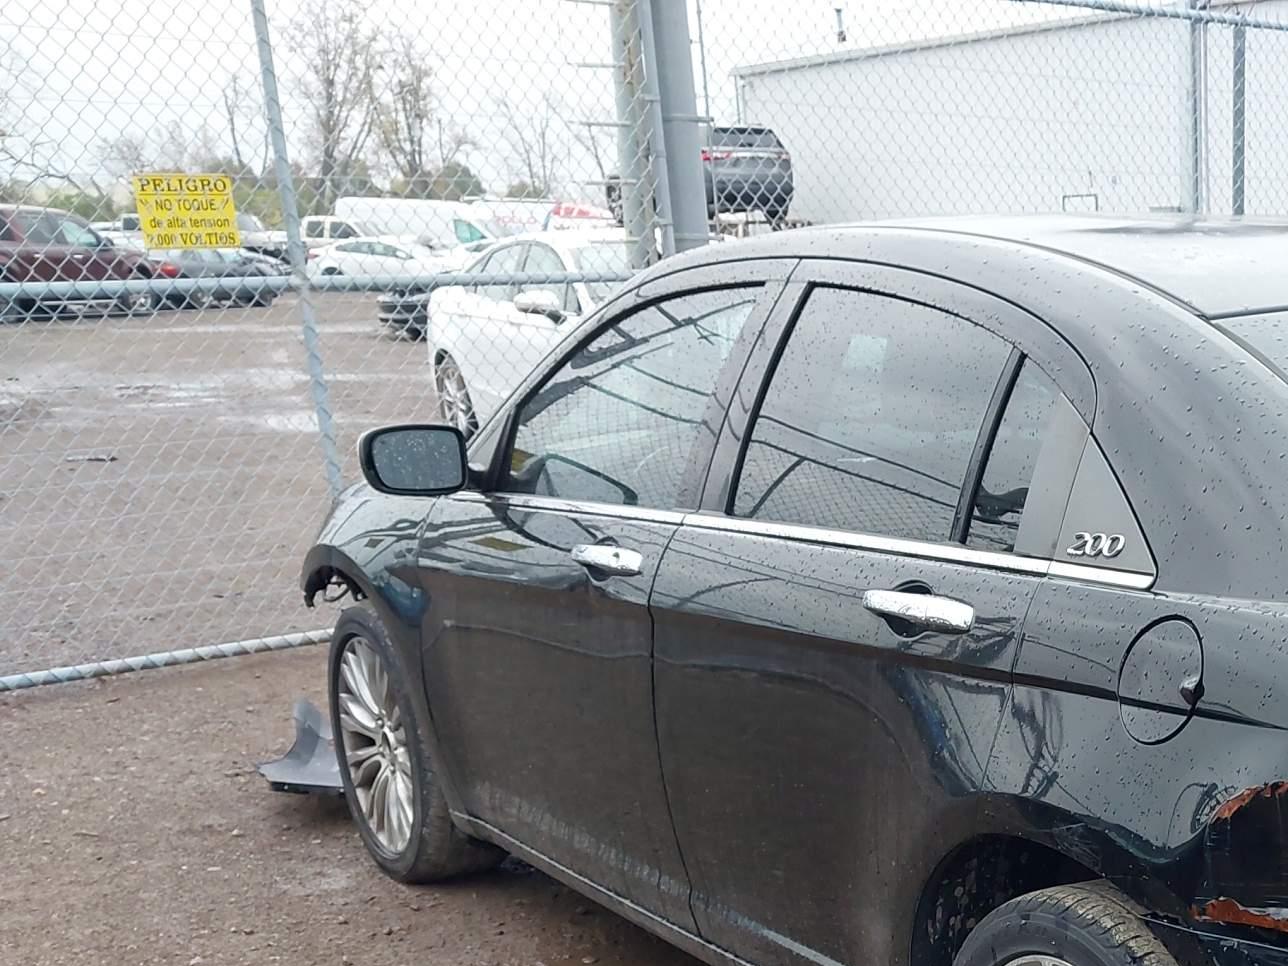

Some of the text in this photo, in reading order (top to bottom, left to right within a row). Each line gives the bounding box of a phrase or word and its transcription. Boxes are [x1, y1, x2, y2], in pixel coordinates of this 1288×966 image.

[139, 178, 227, 192] PELIGRO
[155, 199, 216, 211] NO TOQUE
[150, 217, 162, 228] de
[167, 216, 186, 228] alta
[180, 232, 236, 245] VOLTIOS
[1066, 532, 1125, 558] 200
